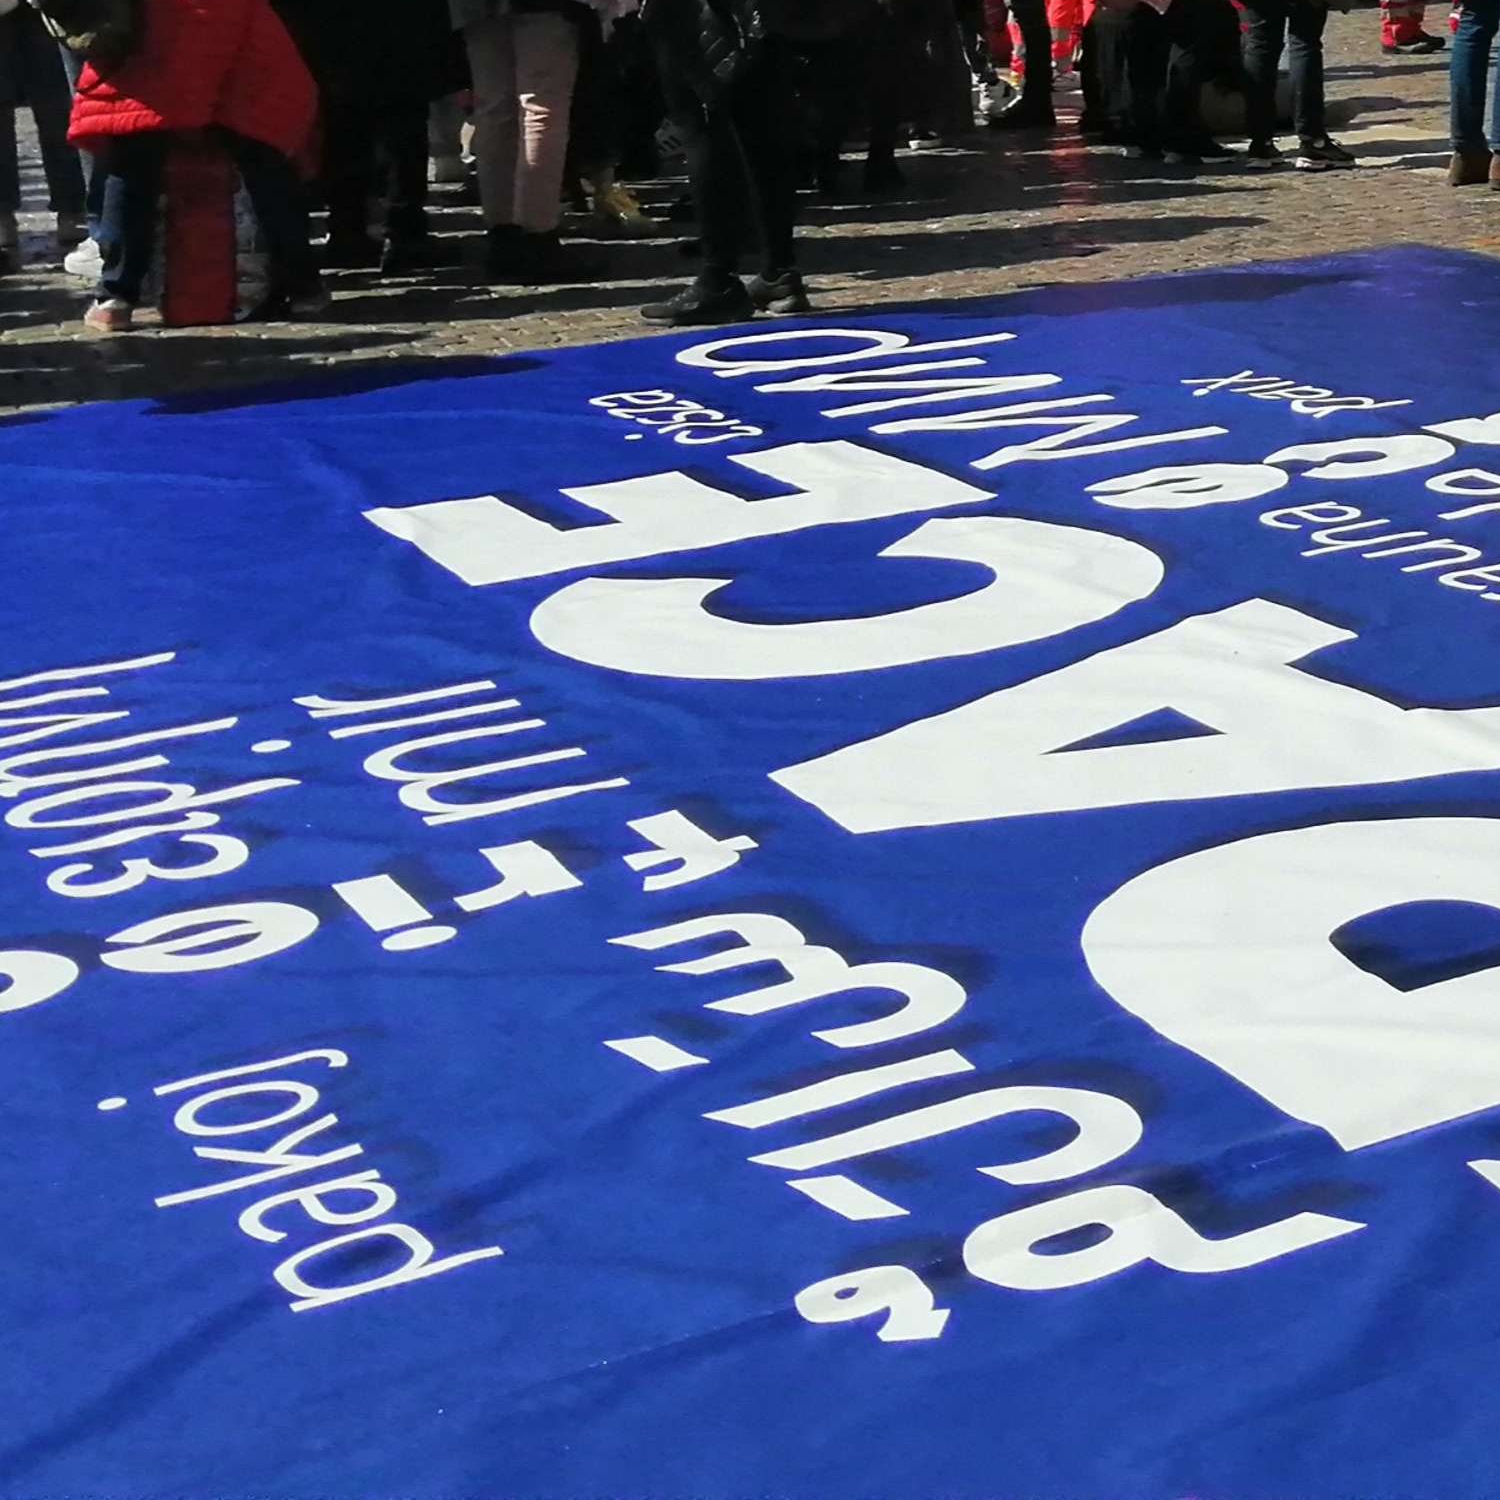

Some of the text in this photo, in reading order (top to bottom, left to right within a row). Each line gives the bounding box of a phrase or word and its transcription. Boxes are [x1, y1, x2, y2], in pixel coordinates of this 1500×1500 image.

[588, 389, 763, 444] cisza
[1180, 368, 1414, 418] paix
[250, 679, 630, 827] mir
[97, 1048, 504, 1313] pakoj
